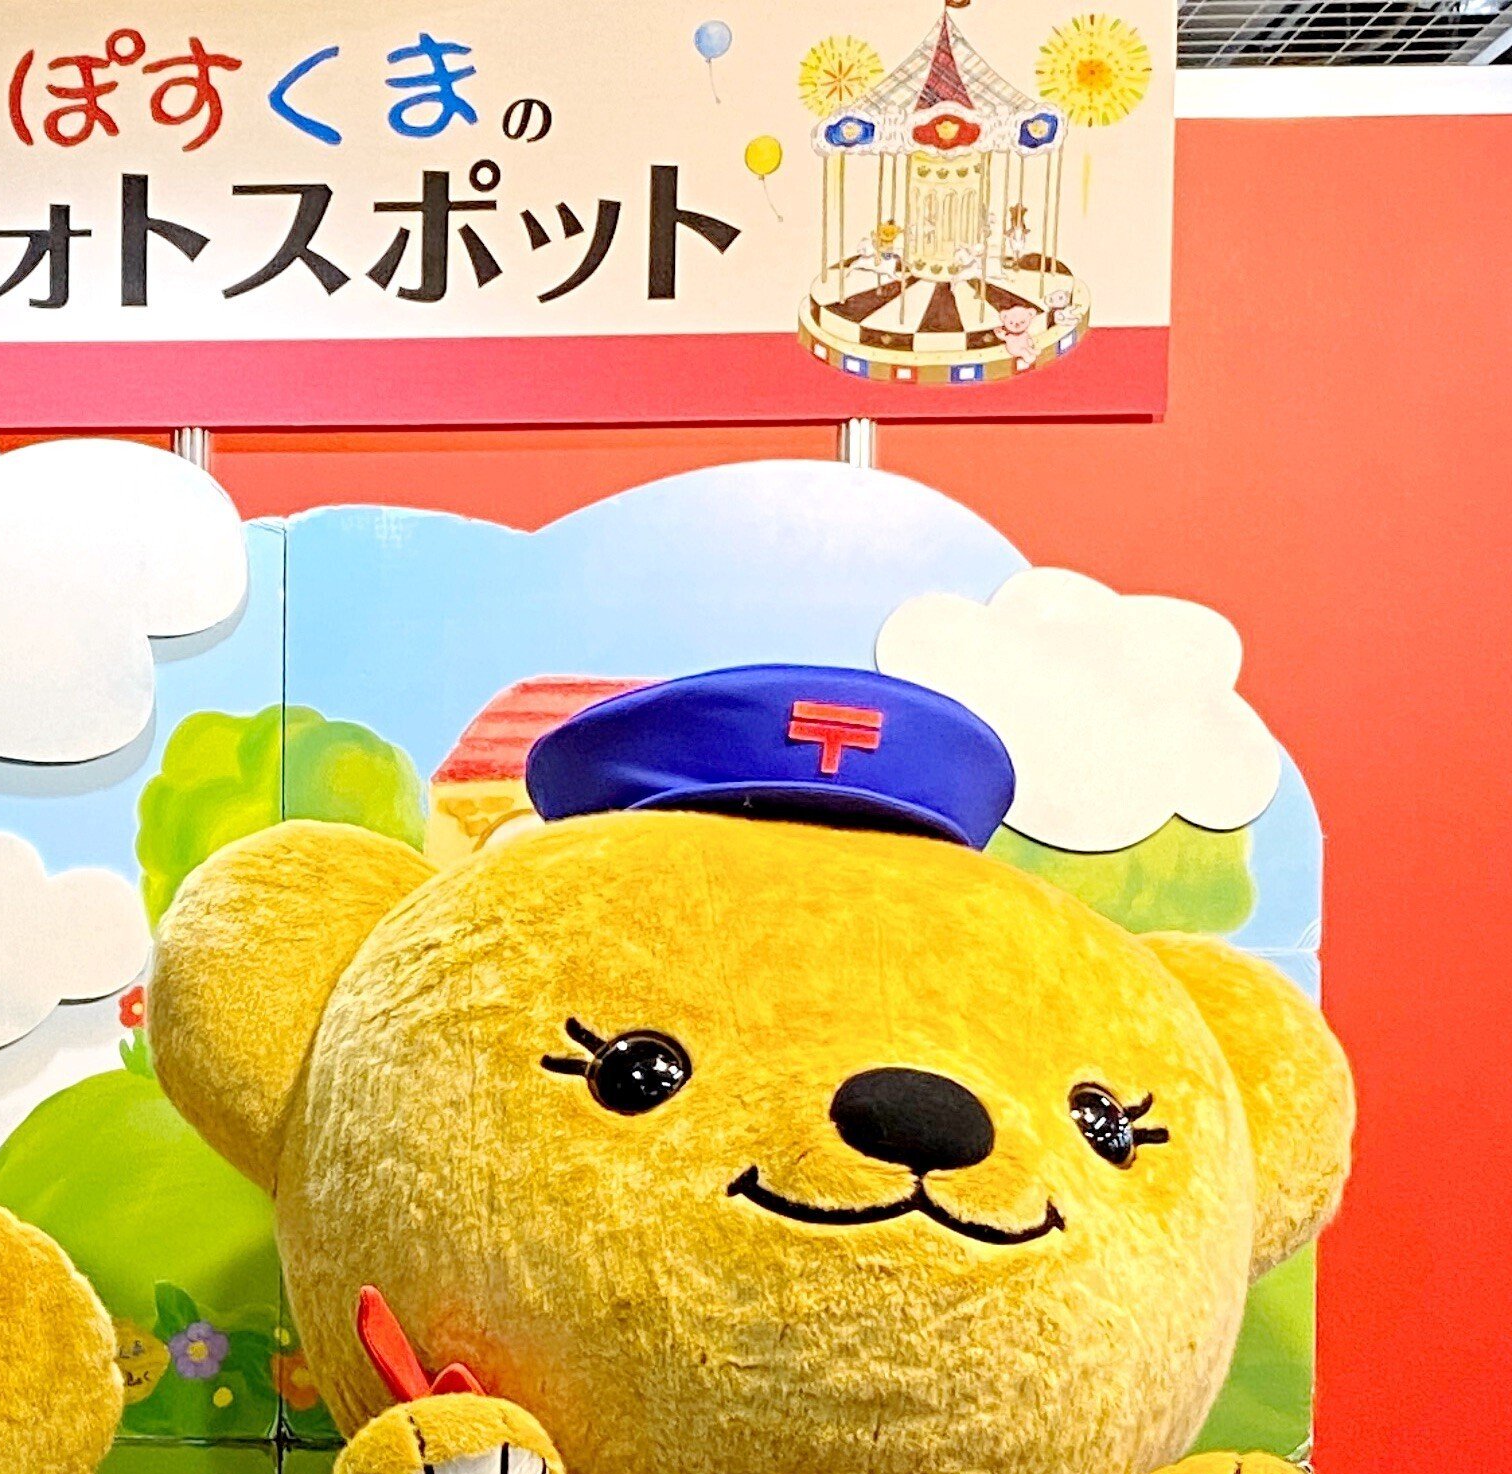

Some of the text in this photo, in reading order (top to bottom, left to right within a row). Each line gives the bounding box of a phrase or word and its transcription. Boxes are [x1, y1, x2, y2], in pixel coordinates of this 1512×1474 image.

[7, 28, 553, 153] ぽすくまの
